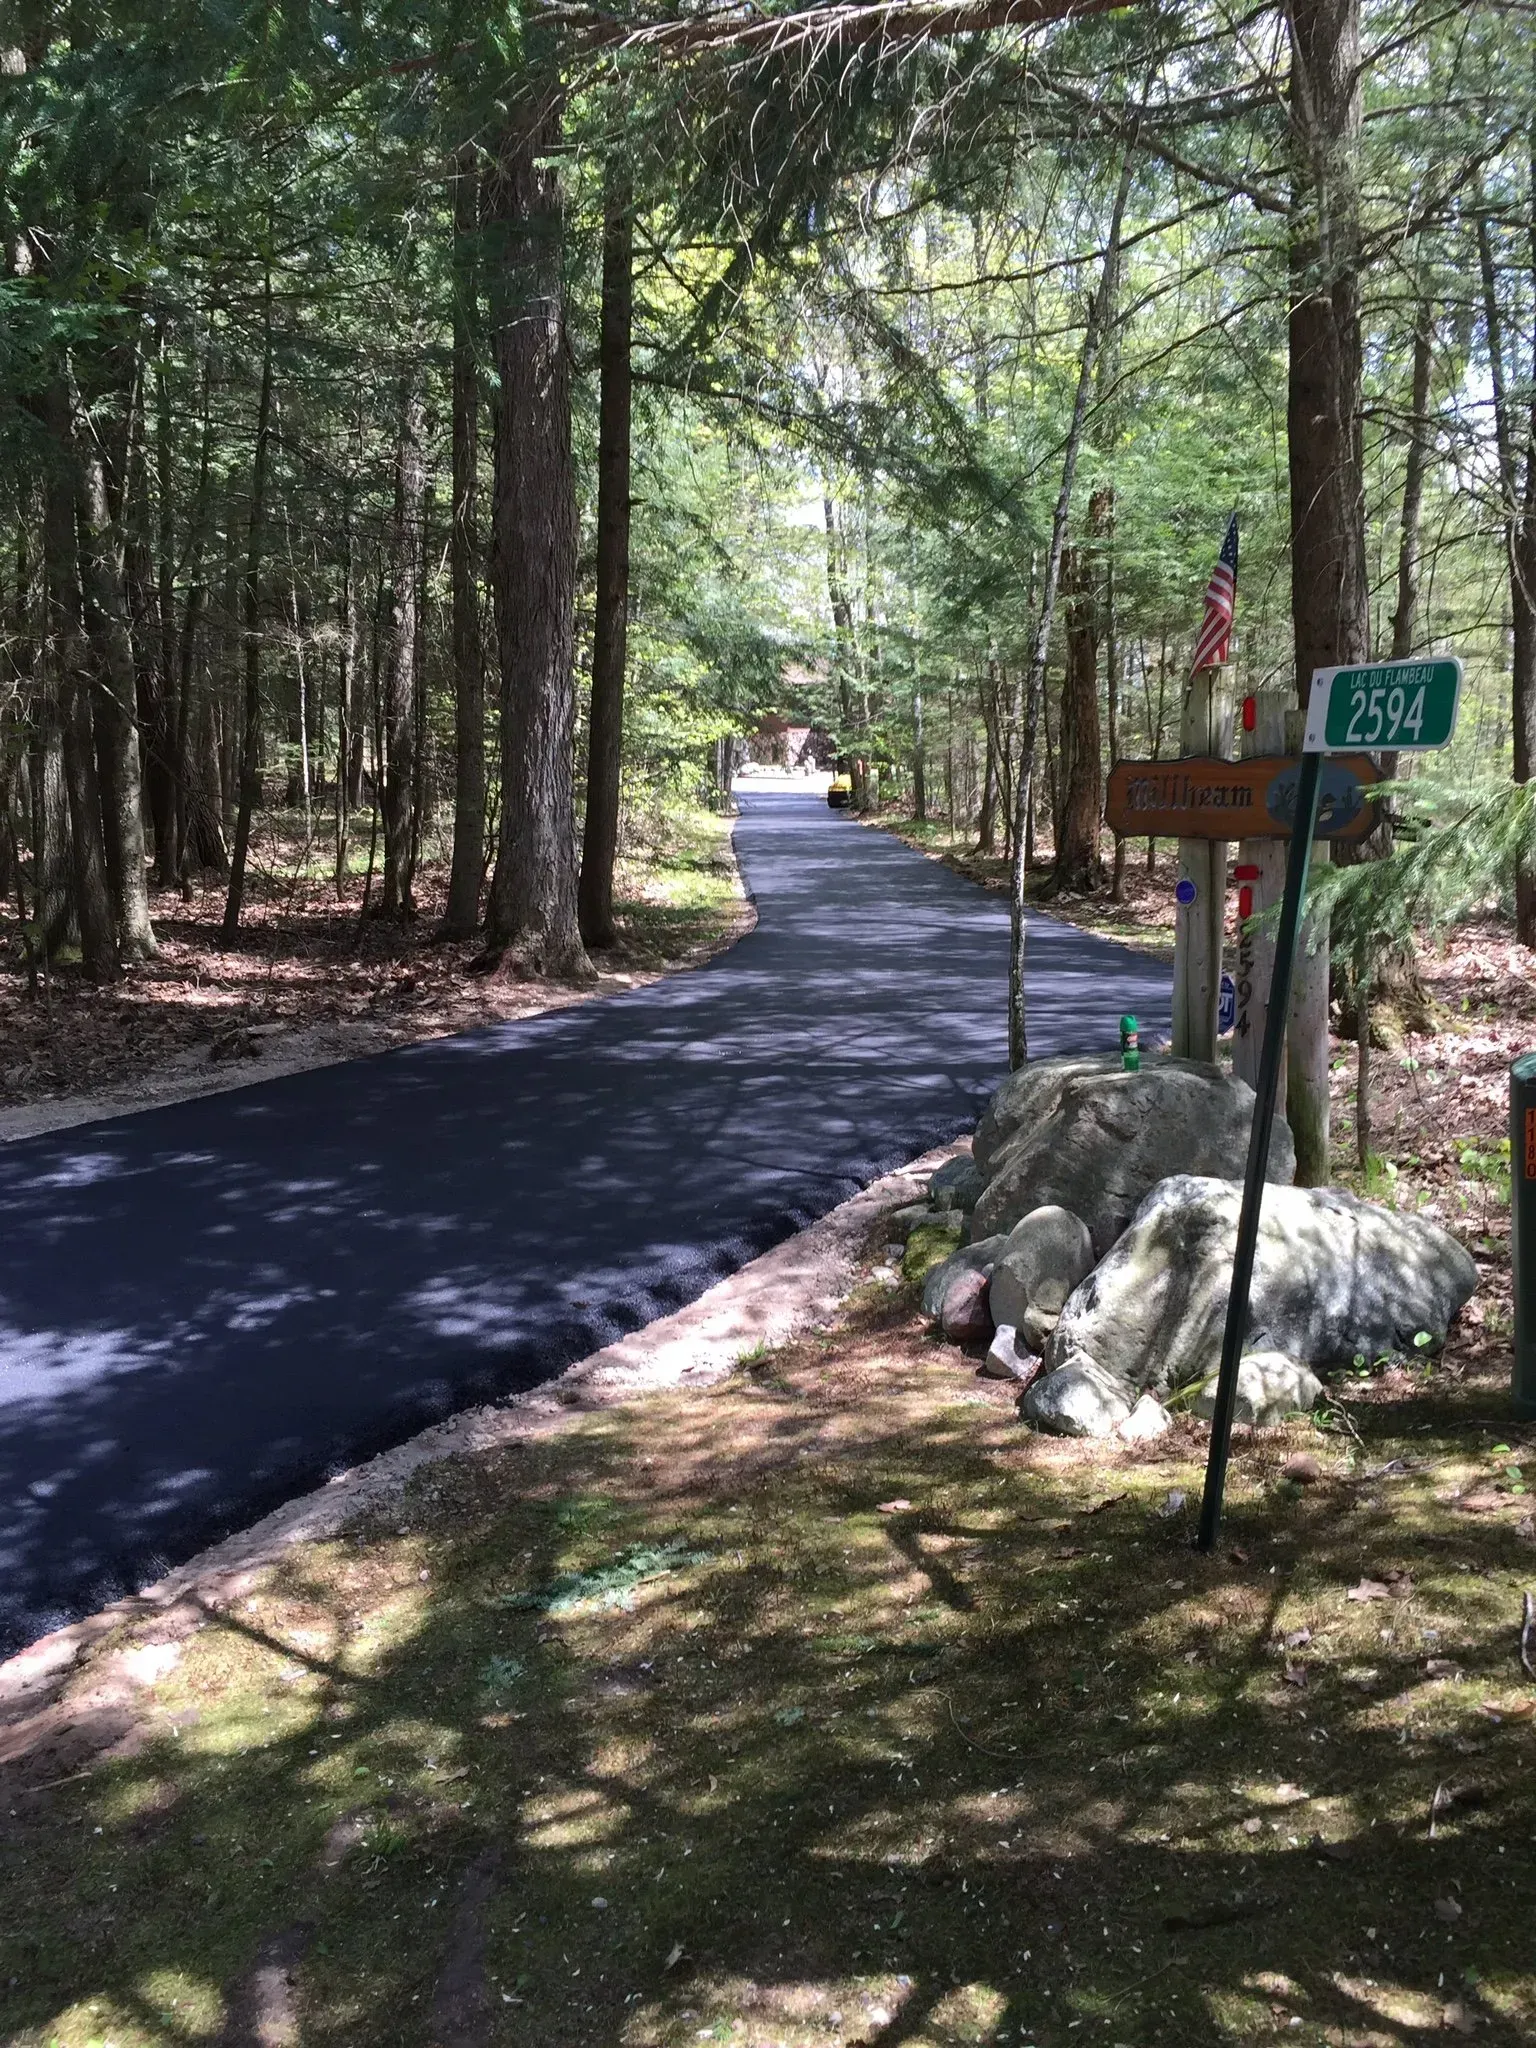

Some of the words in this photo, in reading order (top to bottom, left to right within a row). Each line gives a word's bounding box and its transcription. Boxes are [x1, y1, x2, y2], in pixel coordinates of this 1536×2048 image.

[1350, 672, 1368, 689] LAC
[1369, 669, 1383, 687] DU
[1385, 665, 1435, 686] FLAMBEAU
[1345, 685, 1426, 743] 2594
[1527, 1109, 1536, 1178] 1180
